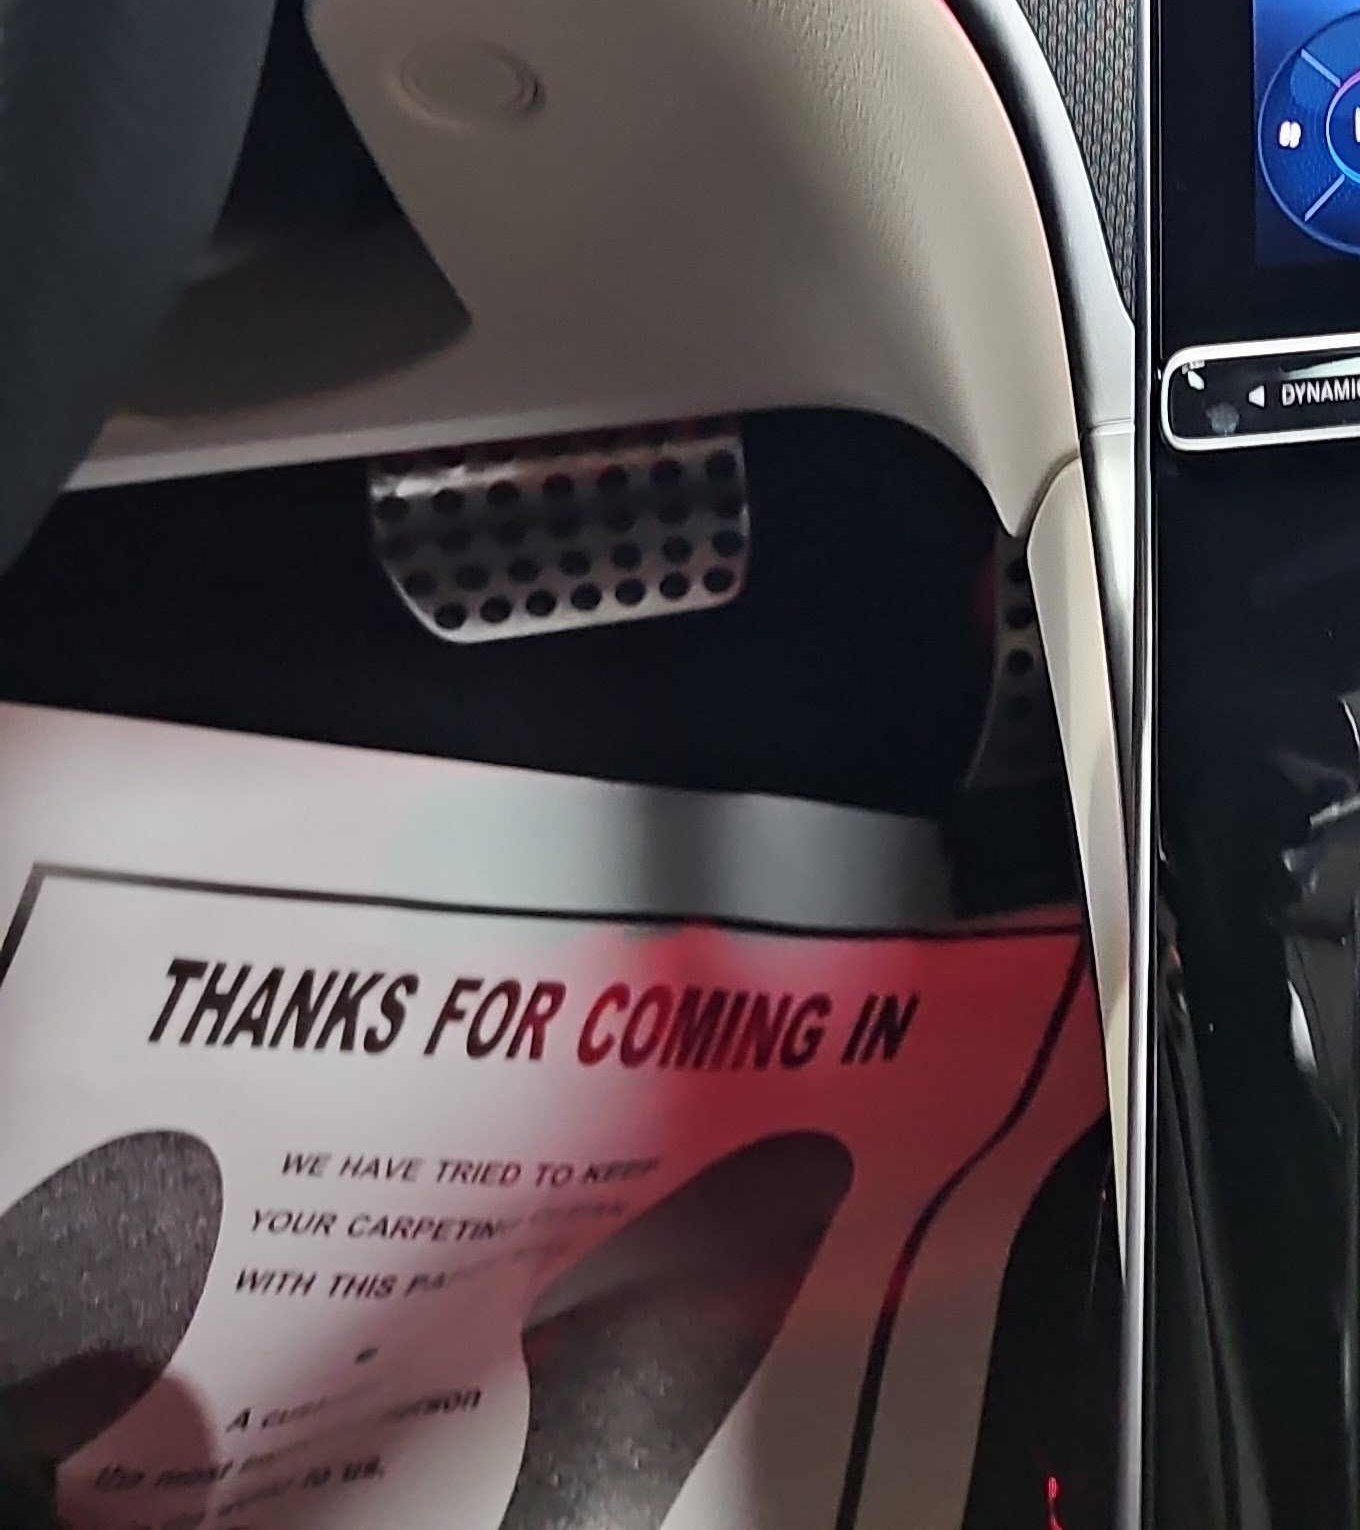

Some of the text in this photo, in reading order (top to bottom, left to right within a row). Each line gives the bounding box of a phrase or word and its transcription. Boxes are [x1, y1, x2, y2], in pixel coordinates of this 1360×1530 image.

[148, 958, 922, 1070] THANKS FOR COMING IN
[282, 1152, 331, 1178] WE
[339, 1155, 425, 1183] HAVE
[437, 1159, 522, 1186] TRIED
[536, 1162, 573, 1188] TO
[252, 1208, 337, 1237] YOUR
[236, 1269, 398, 1299] WITH THIS
[226, 1407, 252, 1434] A
